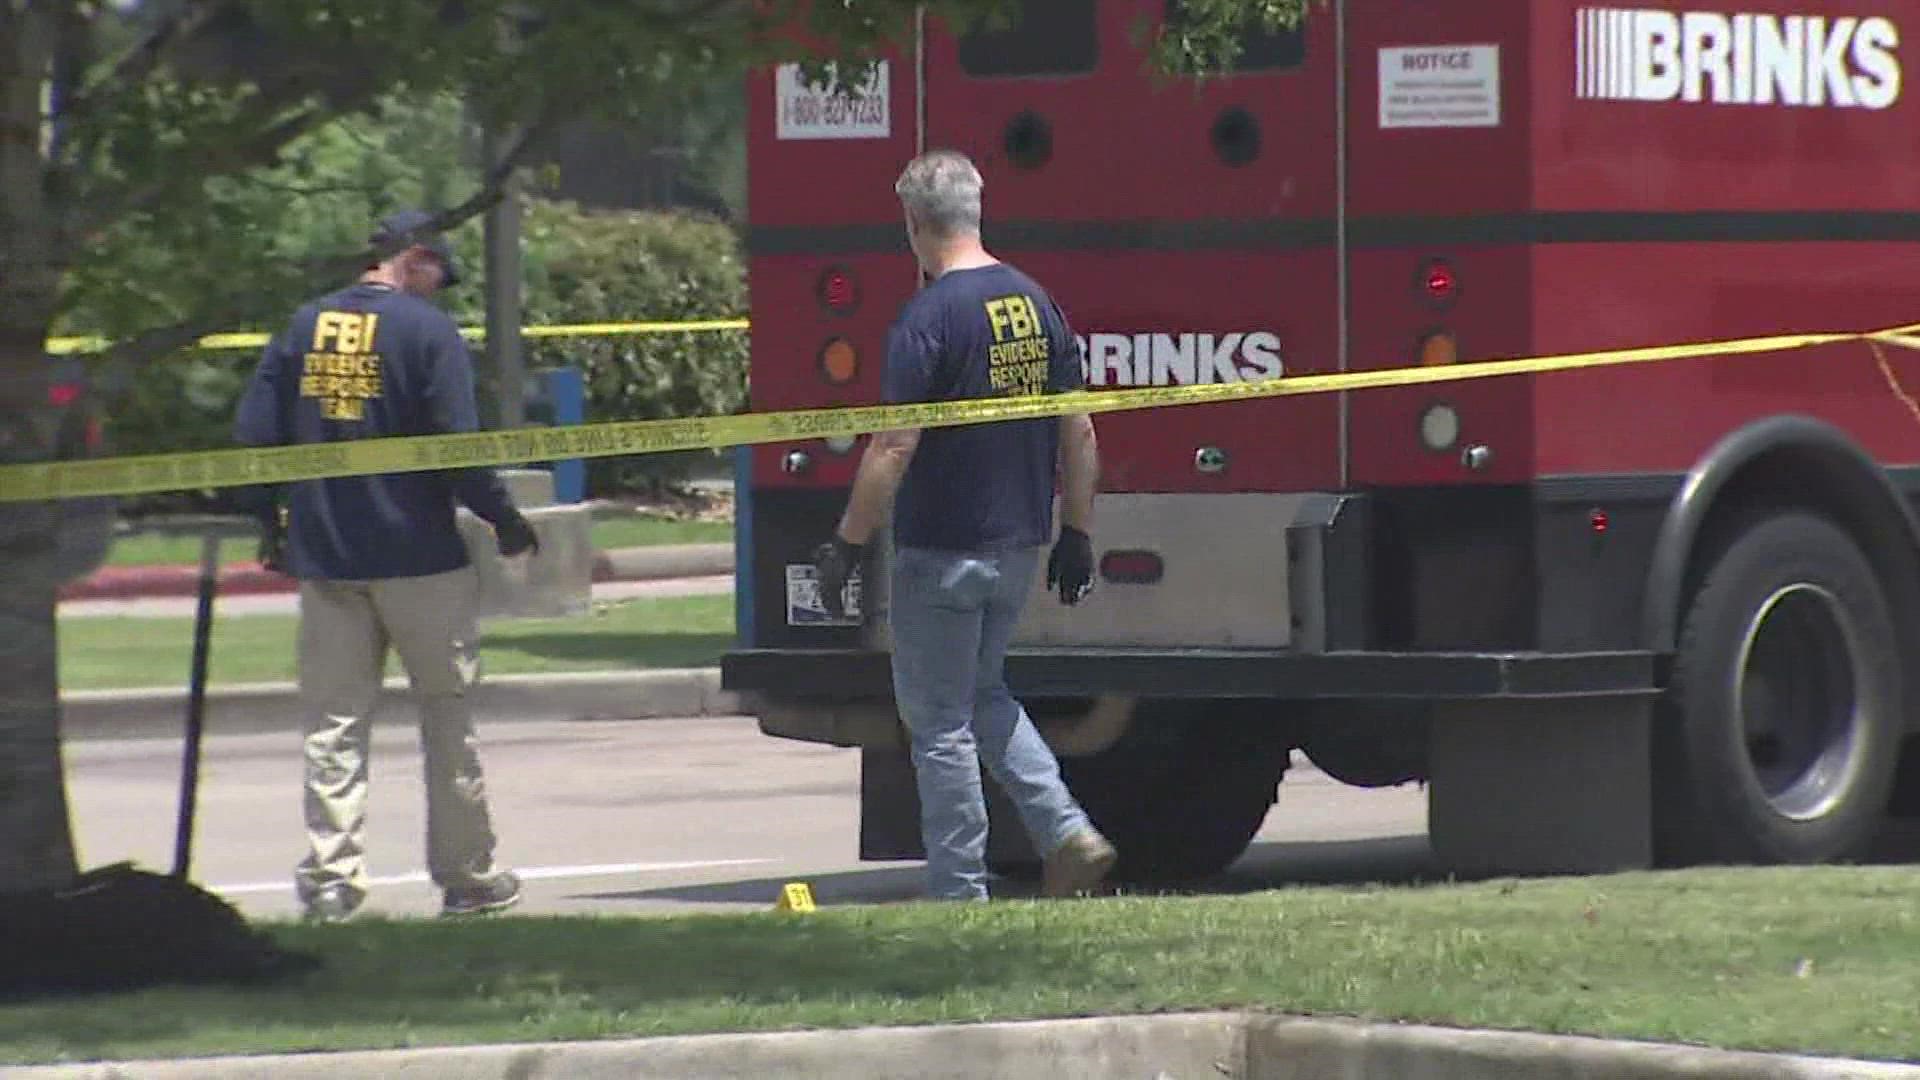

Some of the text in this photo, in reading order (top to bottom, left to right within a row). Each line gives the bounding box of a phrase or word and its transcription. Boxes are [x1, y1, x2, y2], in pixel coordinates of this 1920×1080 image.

[1402, 52, 1471, 71] NOTICE
[1631, 9, 1900, 109] BRINKS
[985, 295, 1042, 341] FBI
[313, 311, 378, 353] FBI
[304, 353, 380, 376] EVIDENCE
[989, 337, 1048, 366] EVIDENCE
[300, 375, 384, 397] RESPONSE
[319, 398, 364, 420] TEAM
